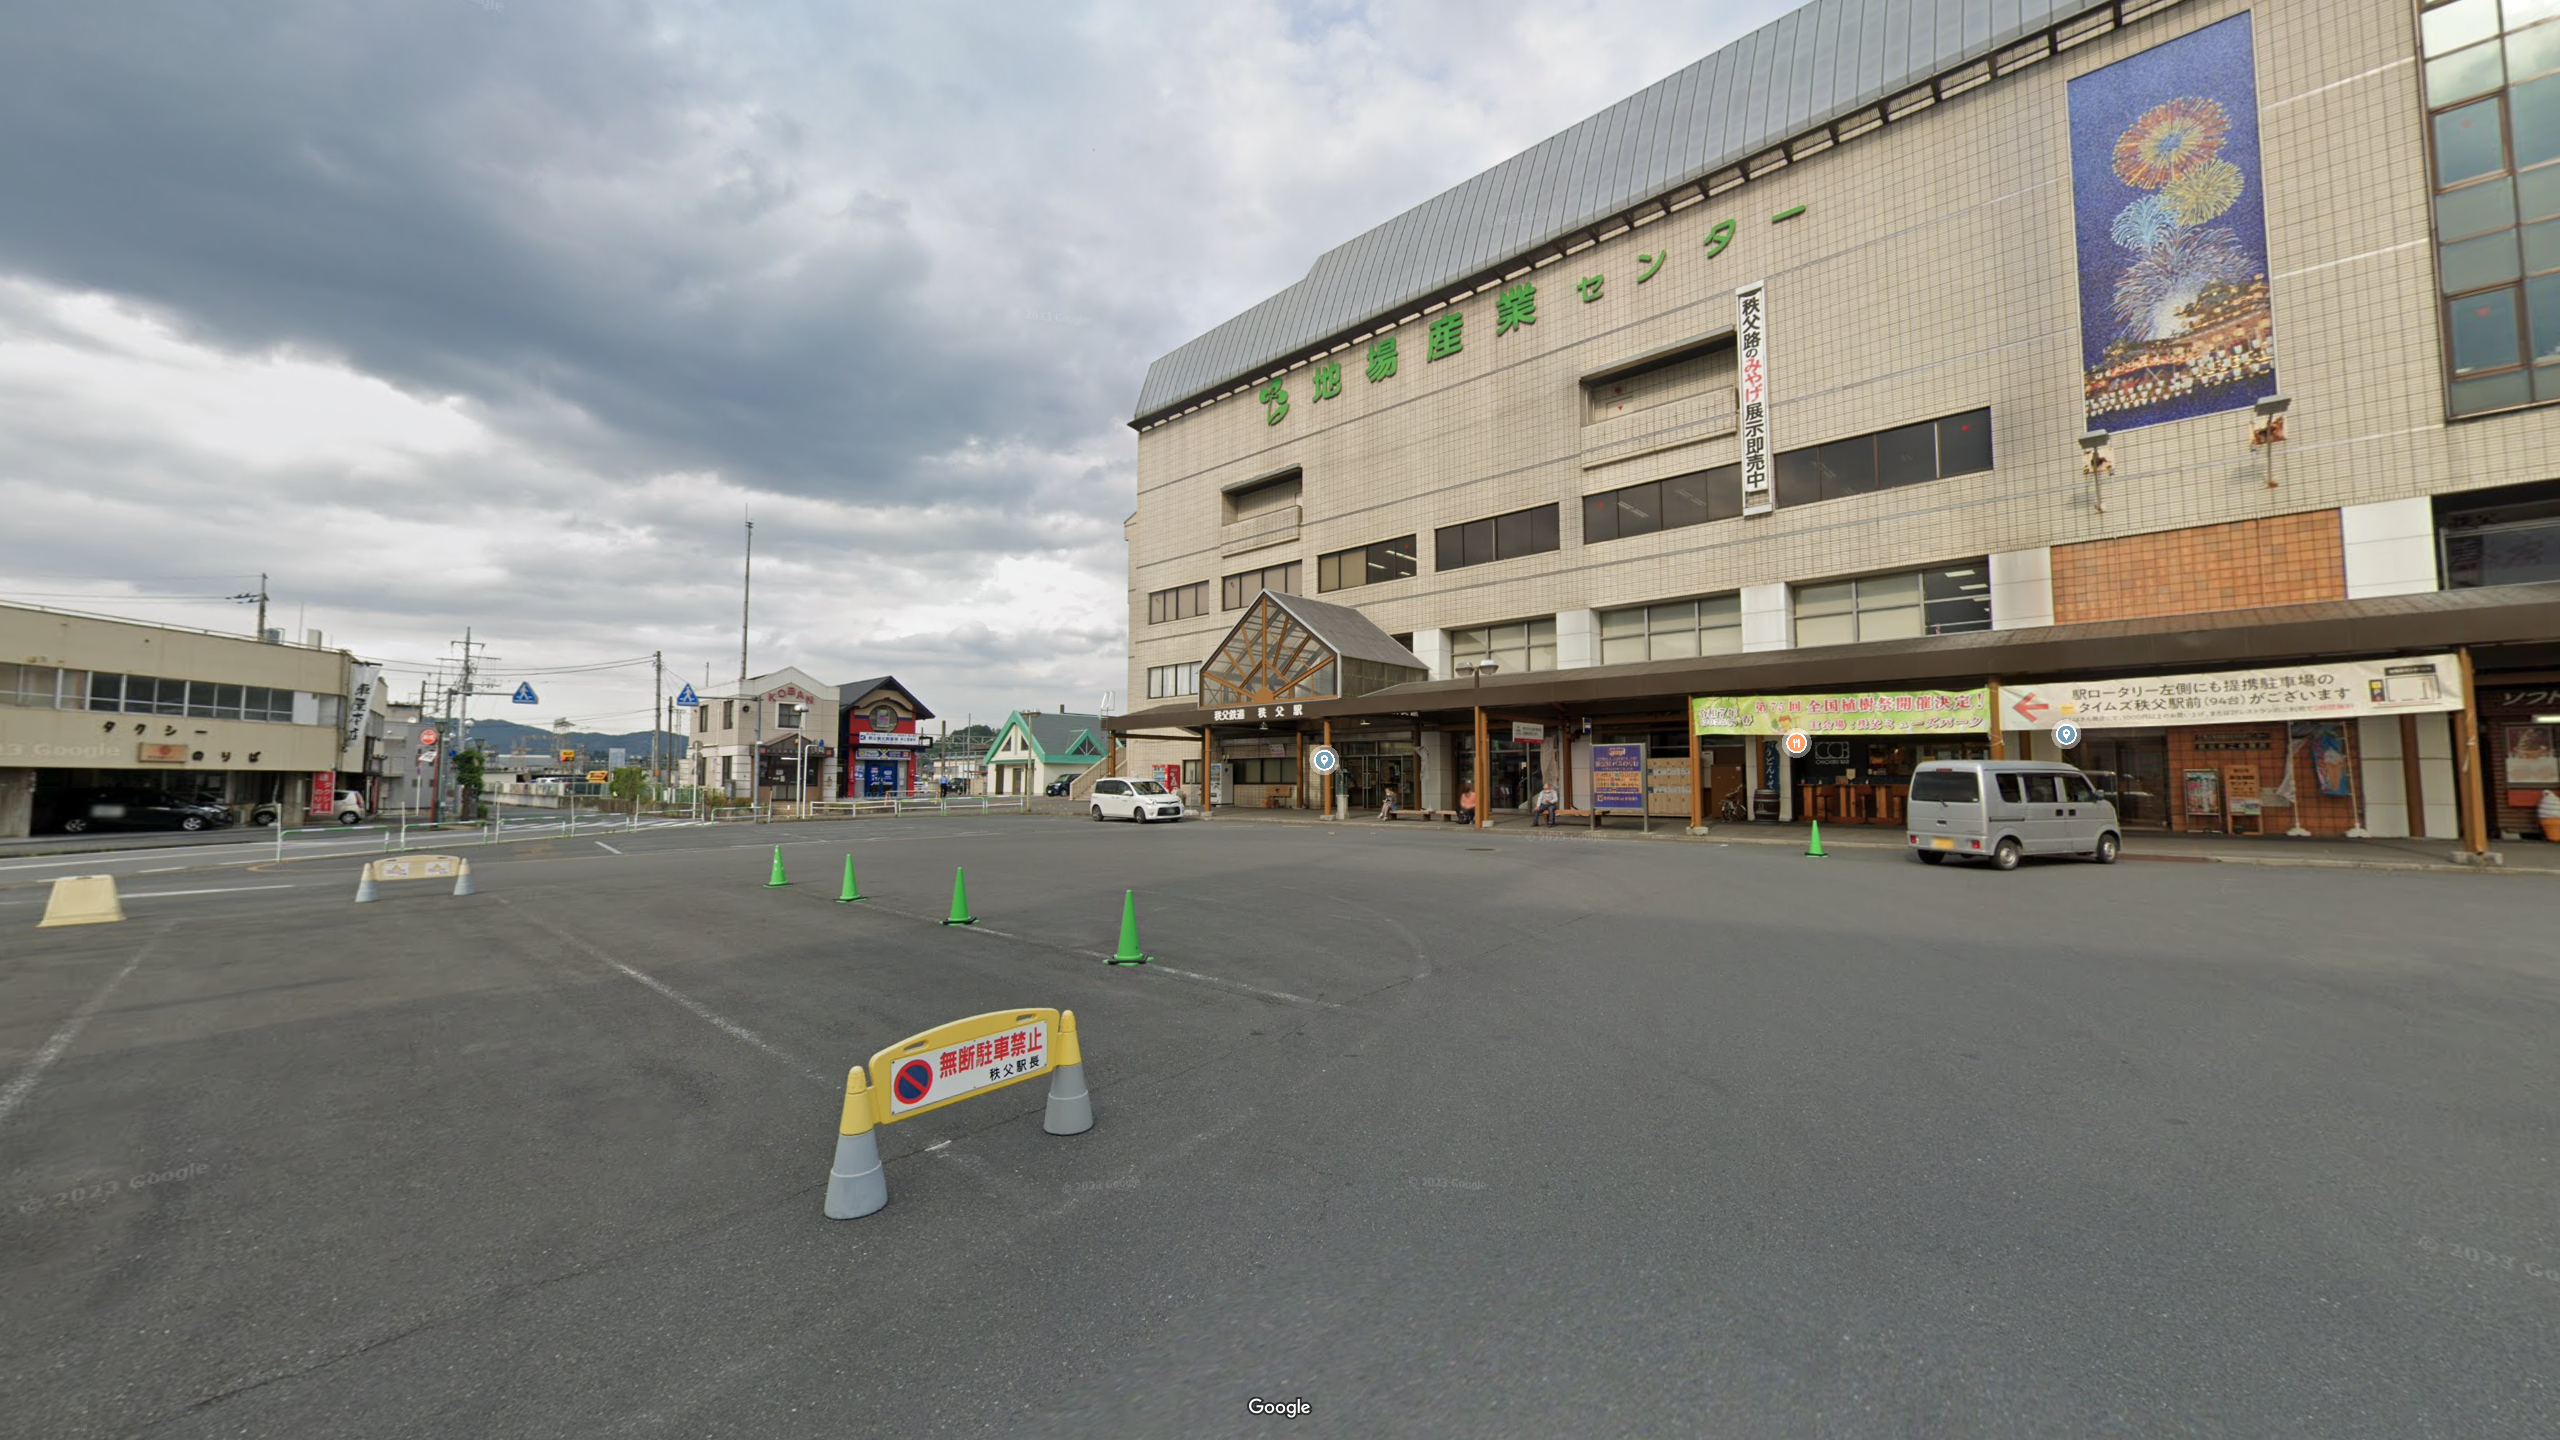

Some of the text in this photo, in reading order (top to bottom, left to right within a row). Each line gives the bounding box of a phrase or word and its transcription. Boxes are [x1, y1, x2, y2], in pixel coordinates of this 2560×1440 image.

[1312, 203, 1807, 404] 地場産業センター
[1740, 293, 1768, 490] 秩父路のみやげ展示即売中
[768, 687, 814, 704] KOBAN
[2072, 673, 2334, 701] 駅ロータリー左側にも提携駐車場の
[1214, 704, 1303, 721] 秩父鉄道 秩父駅
[102, 720, 208, 736] タクシー
[939, 1026, 1043, 1079] 無断駐車禁止
[989, 1055, 1040, 1081] 秩父駅長
